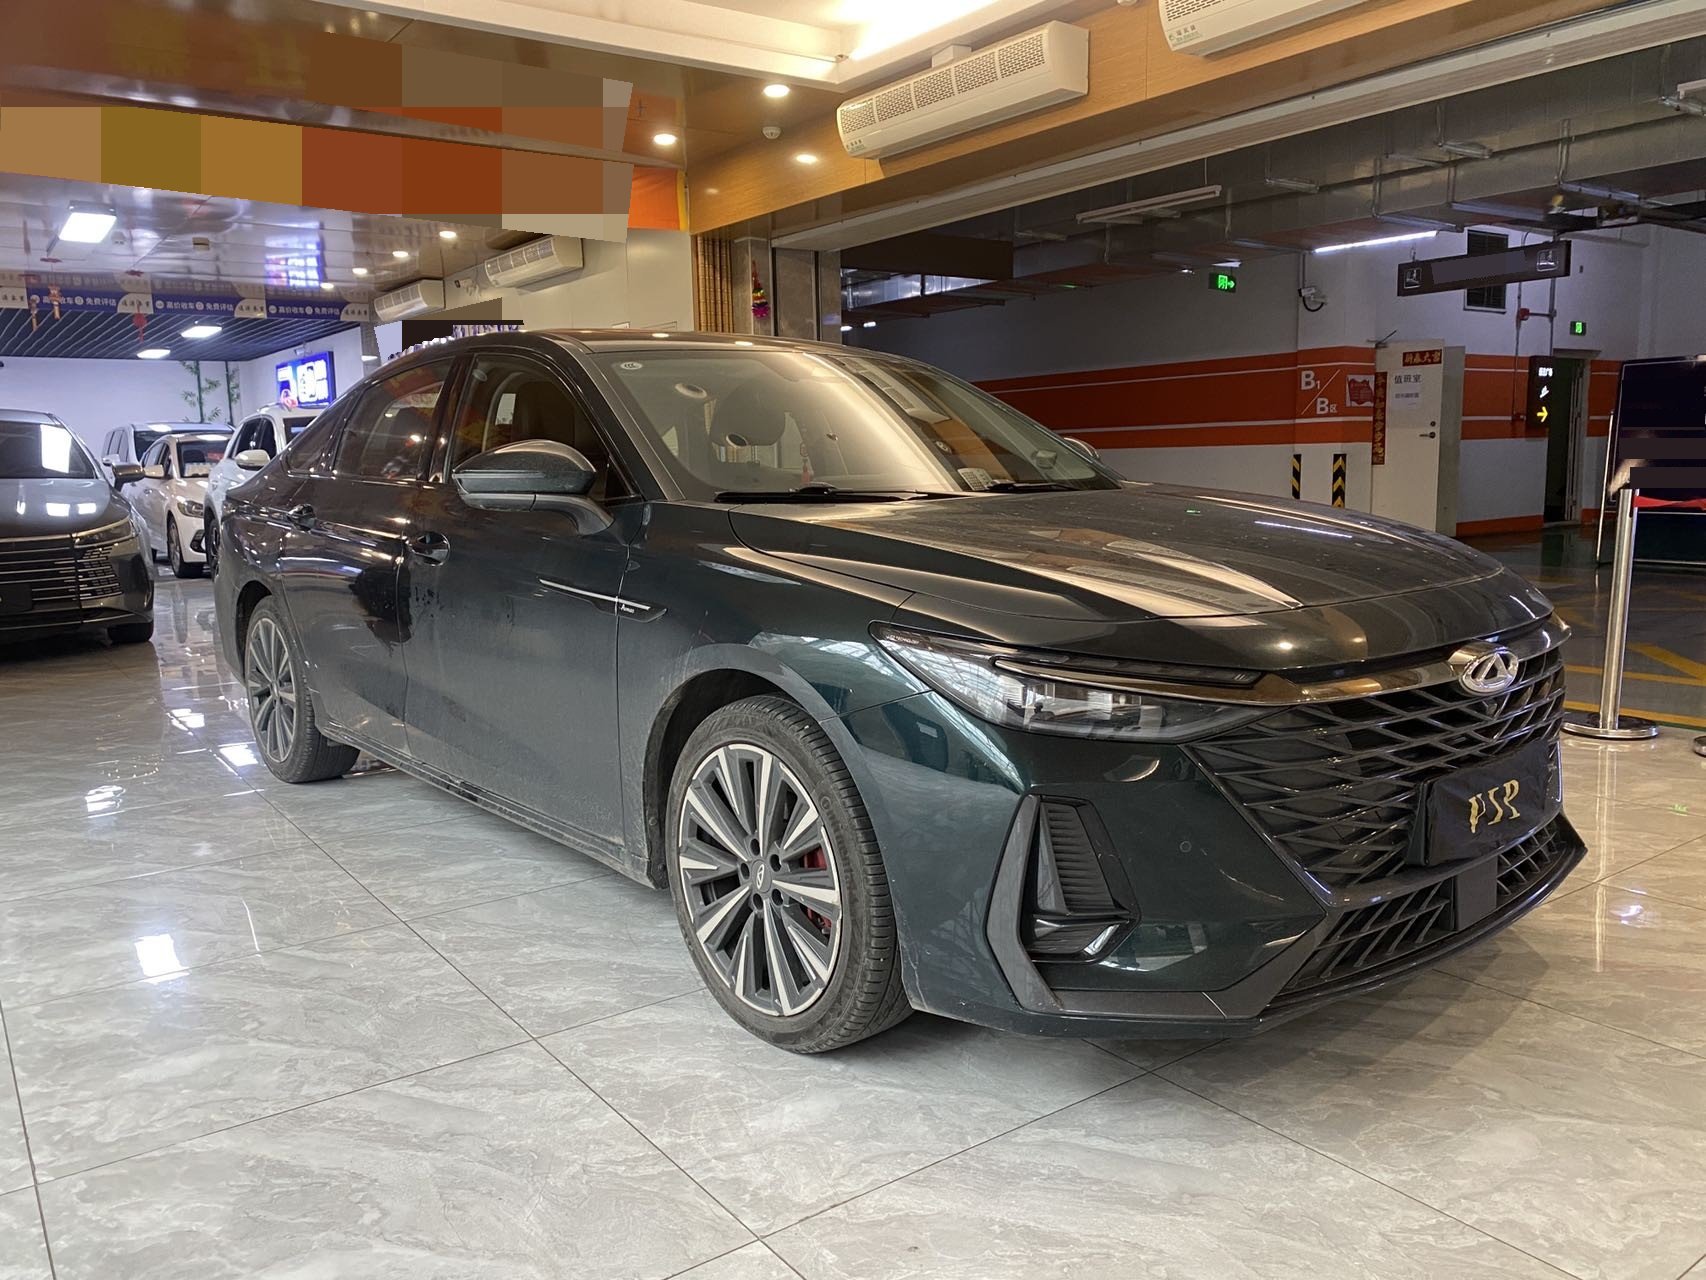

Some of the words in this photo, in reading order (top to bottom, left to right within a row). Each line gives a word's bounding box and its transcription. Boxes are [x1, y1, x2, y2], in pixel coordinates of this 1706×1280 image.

[42, 296, 73, 305] 高收车
[86, 297, 117, 306] 免费评估
[206, 303, 234, 311] 免费评估
[1394, 374, 1421, 384] 值班室
[1316, 397, 1338, 414] B区
